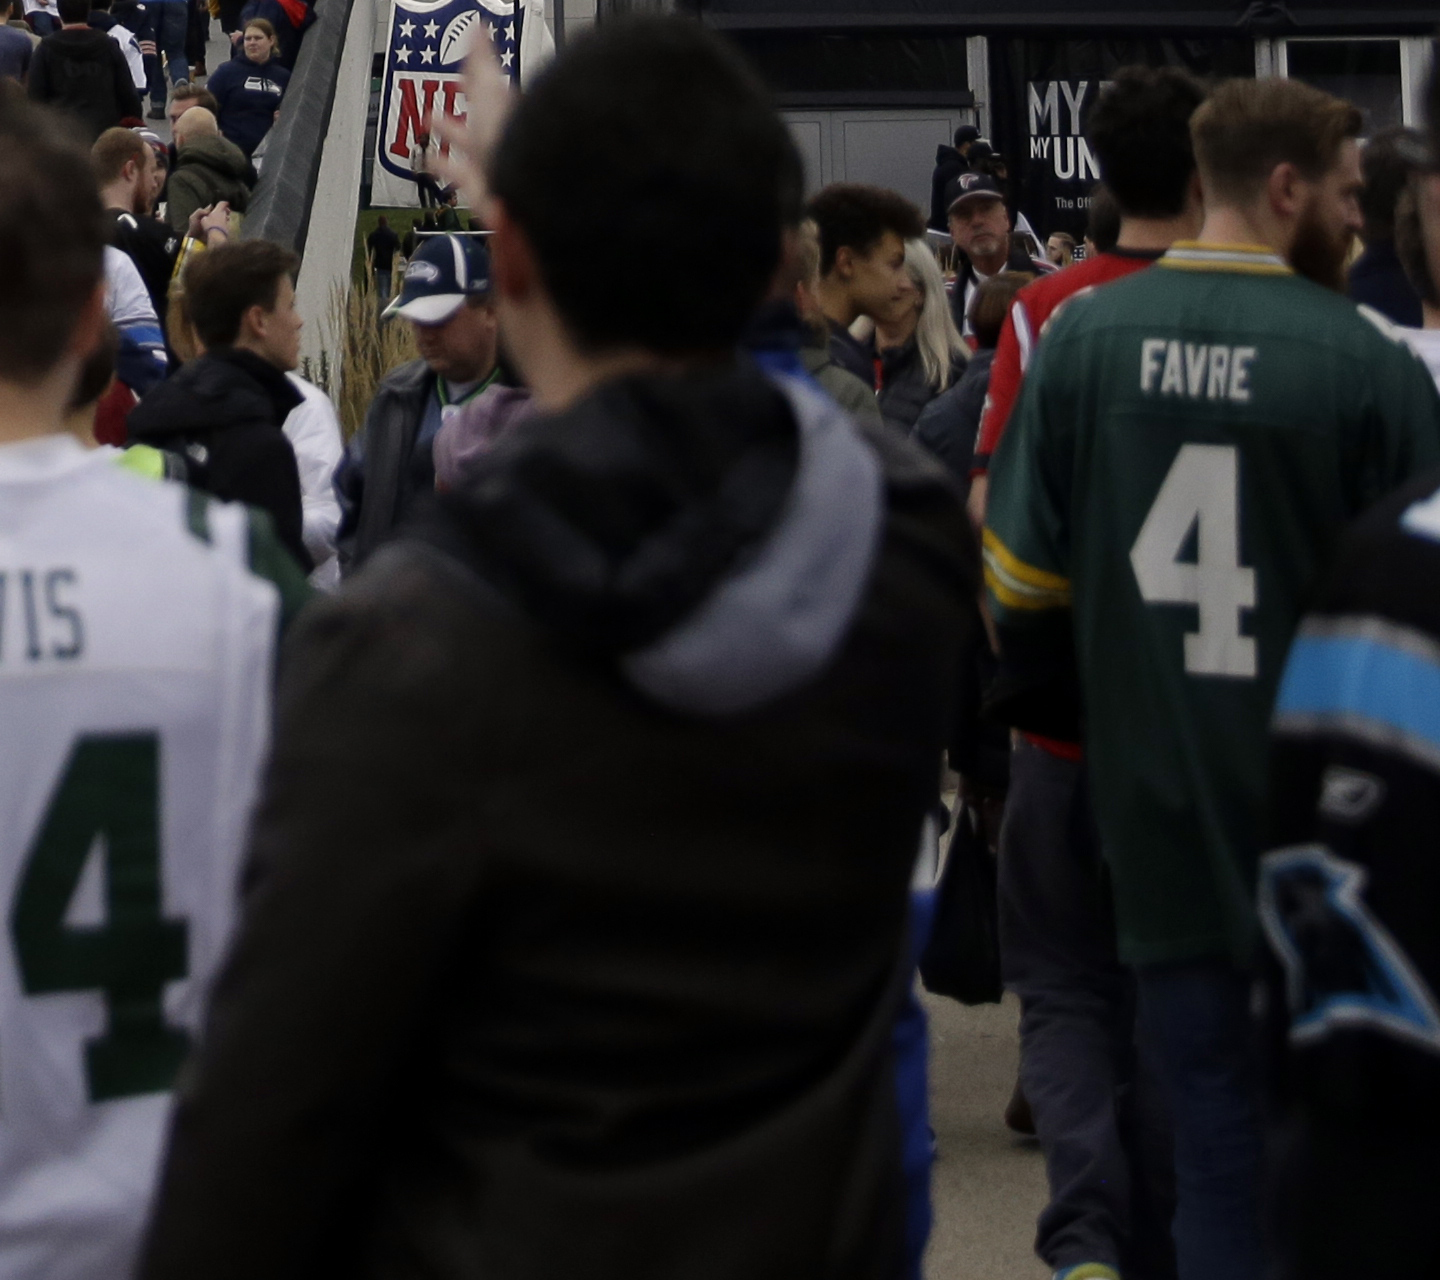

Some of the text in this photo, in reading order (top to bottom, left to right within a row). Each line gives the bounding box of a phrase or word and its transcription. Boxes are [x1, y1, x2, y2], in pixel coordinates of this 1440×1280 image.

[1028, 80, 1088, 135] MY
[1030, 136, 1050, 159] MY
[1055, 197, 1074, 209] The
[1140, 338, 1259, 402] FAVRE
[1129, 442, 1258, 679] 4
